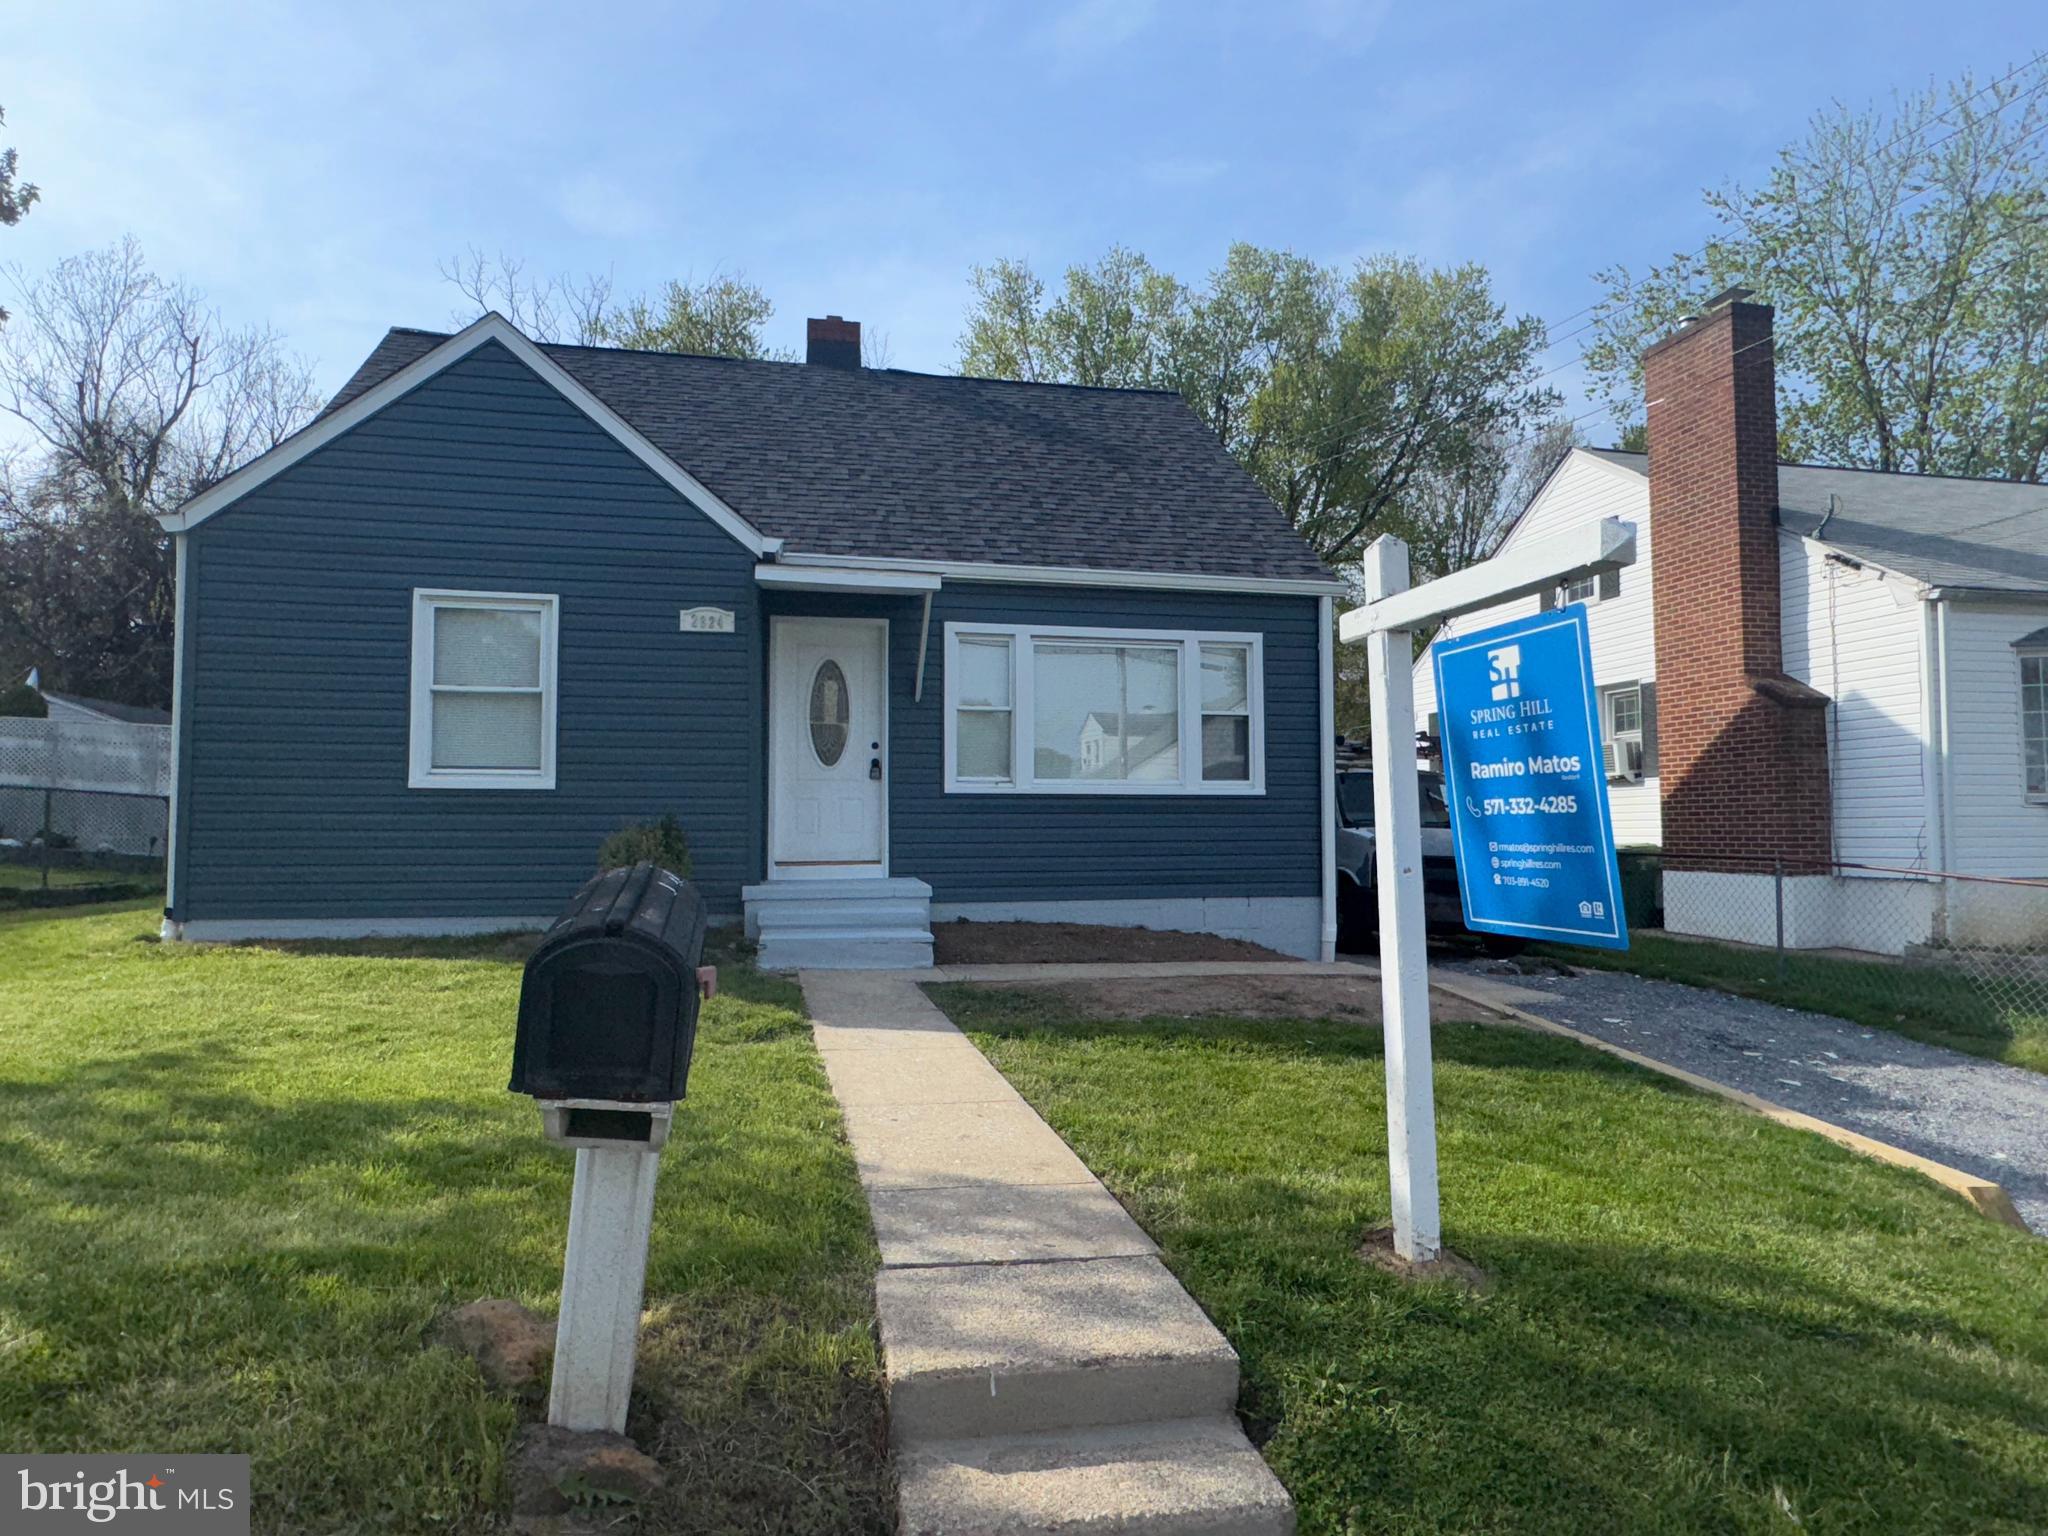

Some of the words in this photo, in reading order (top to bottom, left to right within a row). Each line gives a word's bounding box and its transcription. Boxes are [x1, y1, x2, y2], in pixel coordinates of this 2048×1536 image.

[1470, 704, 1516, 725] SPRING
[1520, 698, 1553, 717] HILL
[1472, 728, 1500, 740] REAL
[1507, 720, 1554, 735] ESTATE
[1470, 757, 1525, 779] Ramiro
[1528, 755, 1581, 775] Matos
[1483, 795, 1578, 816] 571-332-4285
